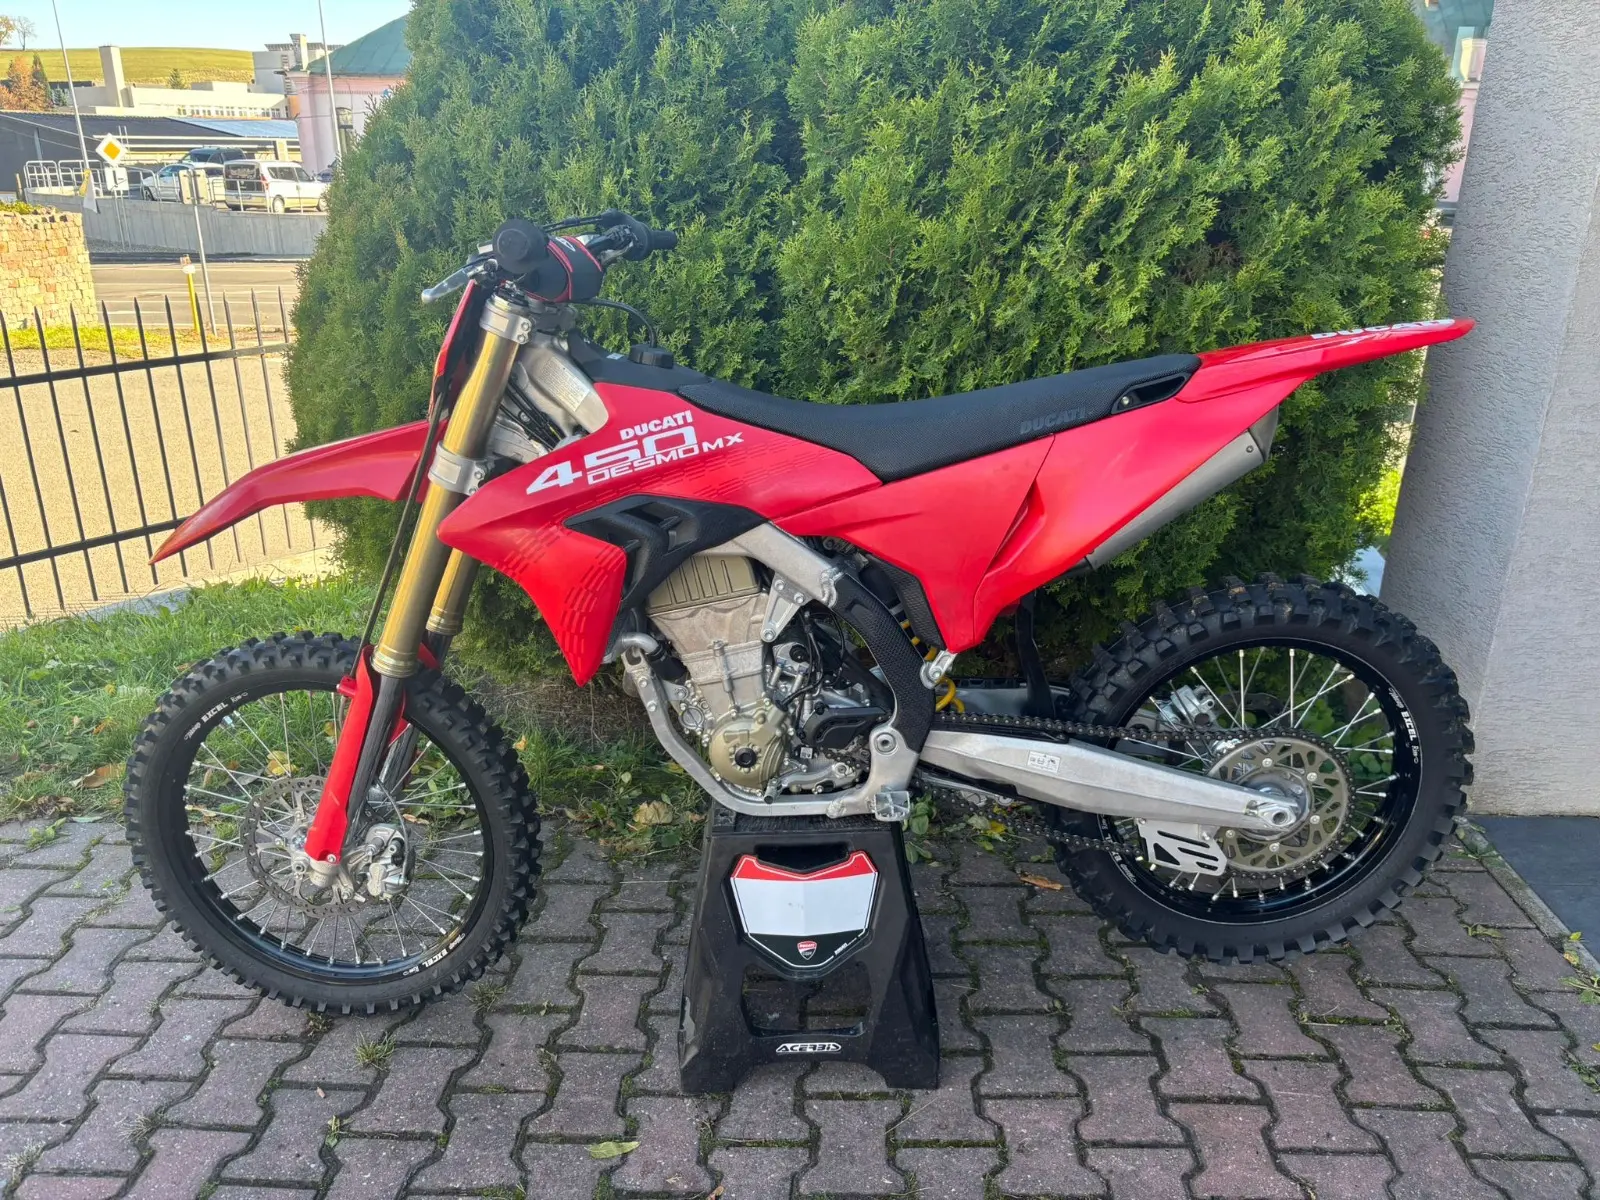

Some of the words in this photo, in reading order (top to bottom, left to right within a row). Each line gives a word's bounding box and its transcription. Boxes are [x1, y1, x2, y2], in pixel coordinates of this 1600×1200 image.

[619, 410, 694, 441] DUCATI
[1020, 407, 1087, 435] DUCATI
[526, 425, 698, 495] 450
[587, 445, 700, 486] DESMO
[702, 432, 744, 453] MX
[201, 702, 228, 723] EXCEL
[1401, 711, 1417, 741] EXCEL
[422, 948, 448, 968] EXCEL
